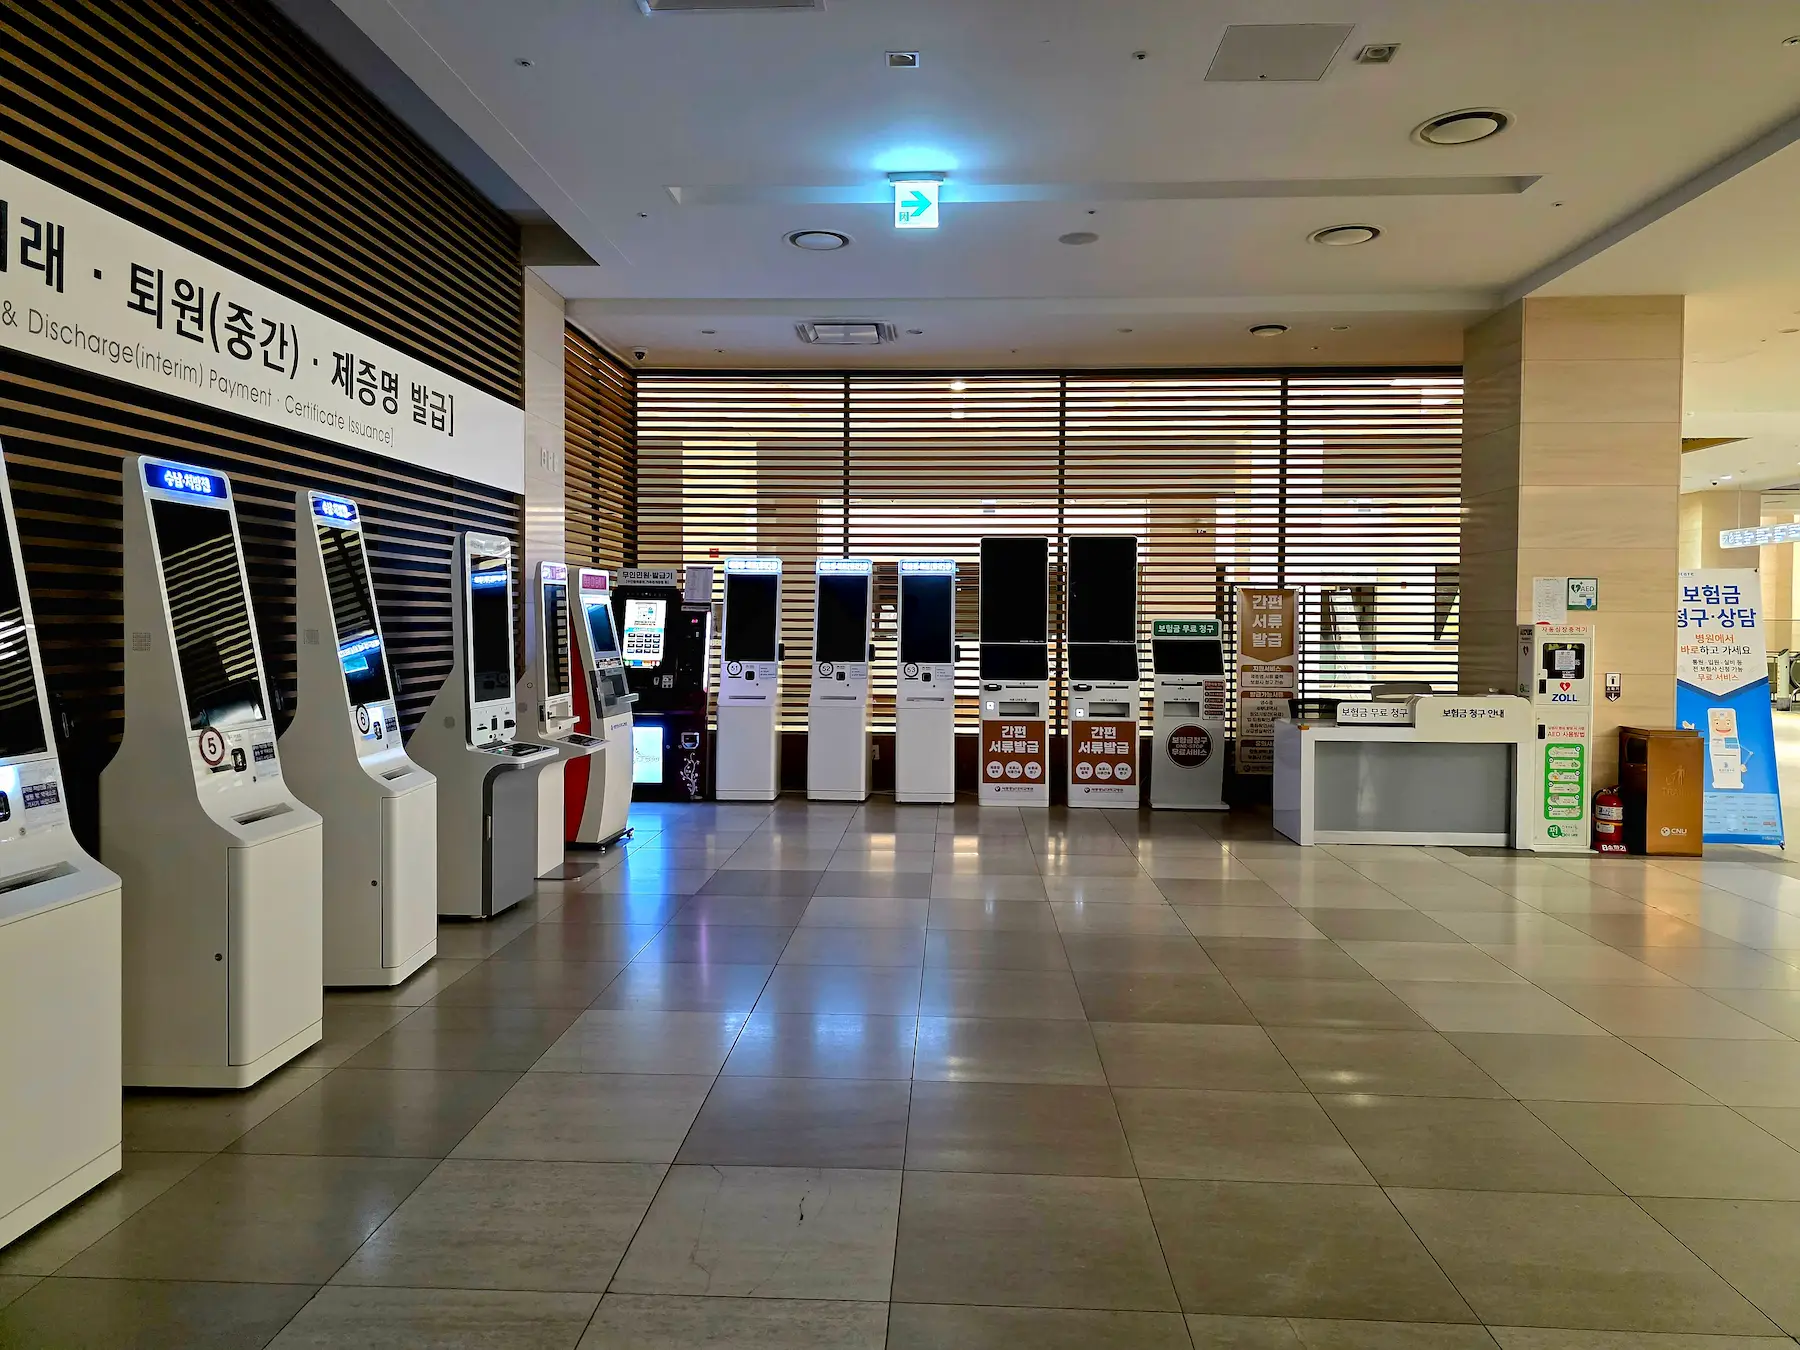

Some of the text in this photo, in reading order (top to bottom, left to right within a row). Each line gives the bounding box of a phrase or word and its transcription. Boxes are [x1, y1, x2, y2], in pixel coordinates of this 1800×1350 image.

[127, 262, 298, 379] 퇴원(중간)
[331, 352, 399, 414] 제증명
[411, 382, 454, 437] 발급]
[2, 300, 394, 447] & Discharge(interim) Payment Certificate Issuance]
[1682, 585, 1740, 604] 보험금
[1252, 595, 1282, 610] 간편
[1252, 614, 1282, 628] 서류
[1158, 624, 1214, 633] 보험금 무료 청구
[1252, 633, 1282, 648] 발급
[1696, 634, 1734, 643] 병원에서
[1681, 646, 1751, 655] 바로하고 가세요
[1698, 673, 1738, 681] 무료 서비스
[1552, 694, 1578, 702] ZOLL
[1342, 708, 1408, 718] 보험금 무료 청구
[1443, 709, 1504, 718] 보험금 청구 안내
[1001, 726, 1026, 738] 간편
[1091, 726, 1116, 739] 간편
[208, 737, 217, 755] 5
[989, 740, 1039, 754] 서류발급
[1078, 742, 1129, 755] 서류발급
